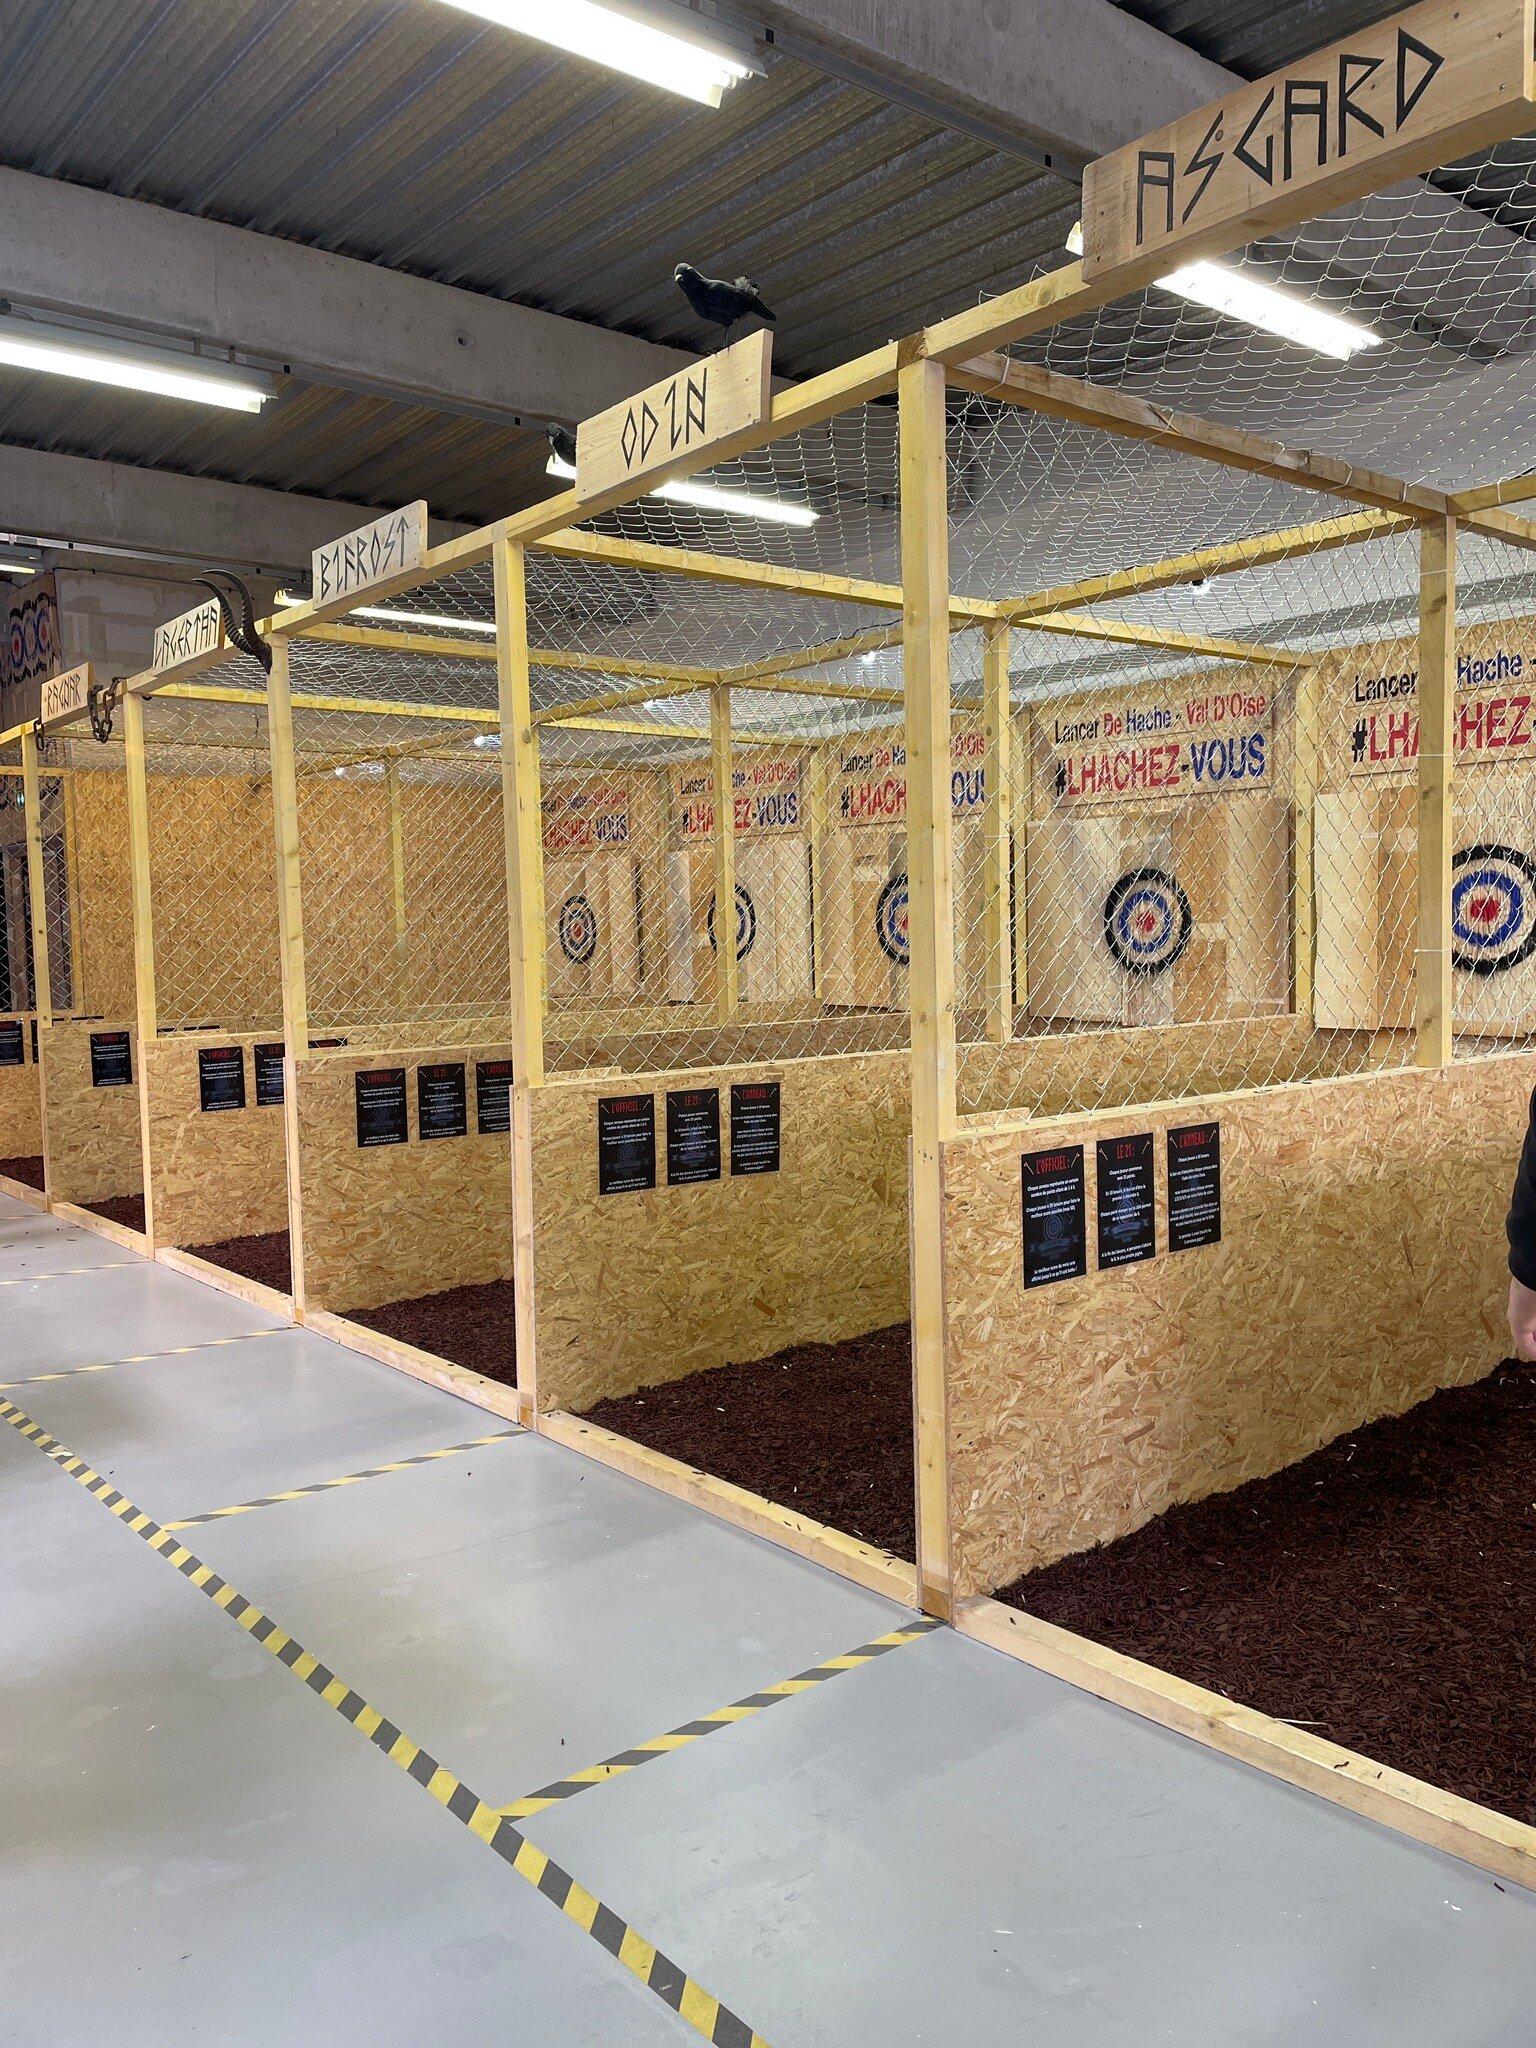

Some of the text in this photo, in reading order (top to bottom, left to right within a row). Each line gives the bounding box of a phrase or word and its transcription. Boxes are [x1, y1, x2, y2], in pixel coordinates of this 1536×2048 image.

[1135, 26, 1445, 246] ASGARD
[620, 366, 707, 471] ODIN
[1355, 671, 1419, 702] Lancer
[1457, 650, 1522, 685] Hache
[1055, 718, 1100, 744] Lancer
[1103, 712, 1123, 736] De
[1126, 706, 1172, 734] Hache
[1185, 698, 1209, 725] Val
[1213, 692, 1266, 723] D'Oise
[1036, 1155, 1067, 1174] L'OFFICIEL
[1116, 1145, 1124, 1160] LE
